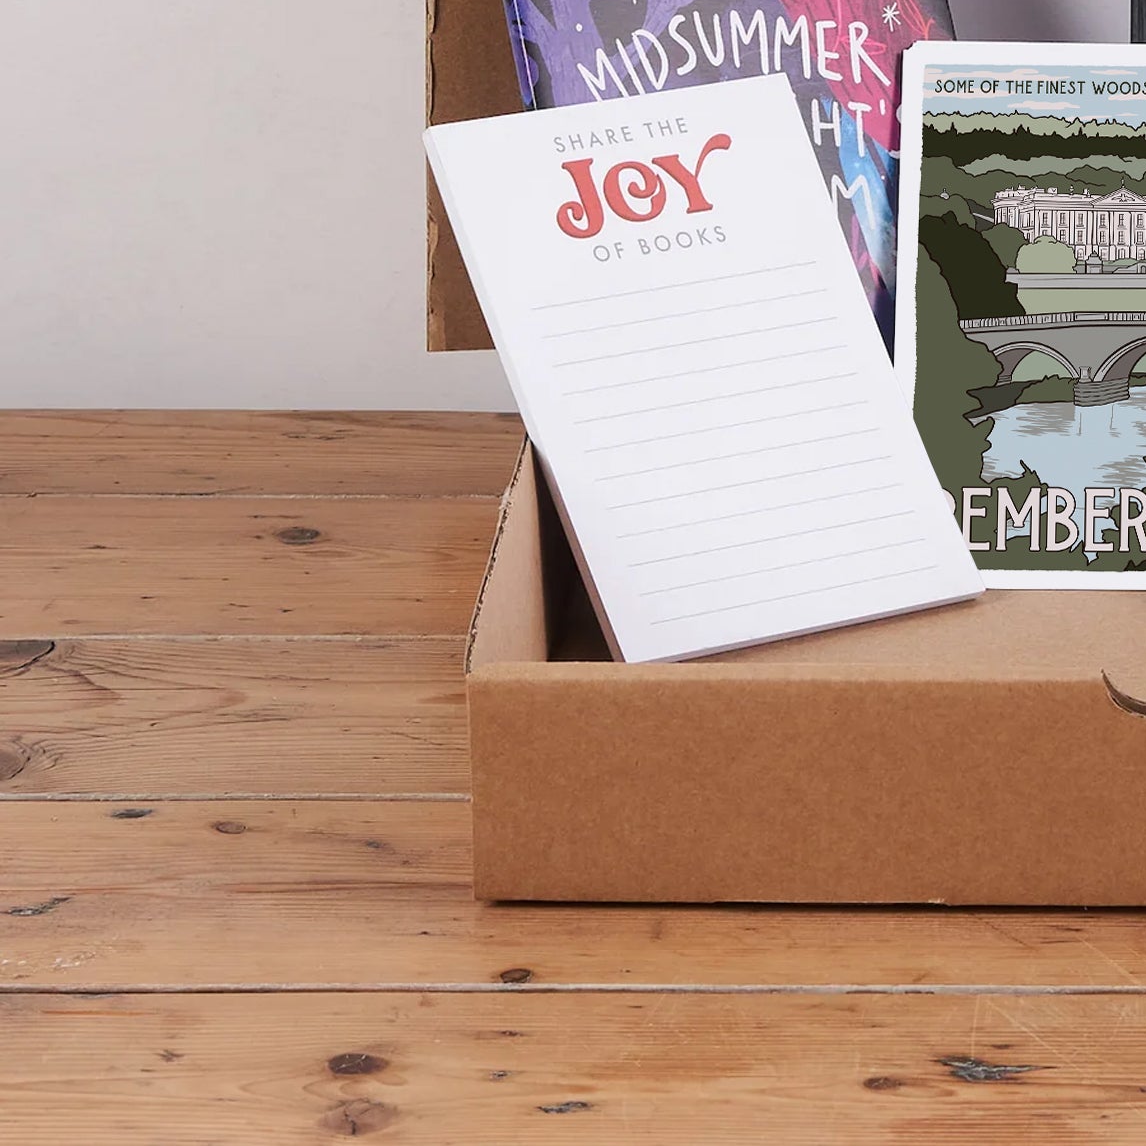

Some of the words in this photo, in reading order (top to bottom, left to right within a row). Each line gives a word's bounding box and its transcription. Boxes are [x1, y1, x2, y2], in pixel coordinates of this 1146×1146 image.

[577, 9, 891, 103] MIDSUMMER
[934, 80, 975, 95] SOME
[980, 80, 1000, 94] OF
[1006, 80, 1033, 94] THE
[1037, 80, 1086, 95] FINEST
[553, 126, 634, 152] SHARE
[643, 118, 688, 139] THE
[556, 133, 732, 239] JOY
[592, 242, 624, 262] OF
[638, 225, 727, 255] BOOKS
